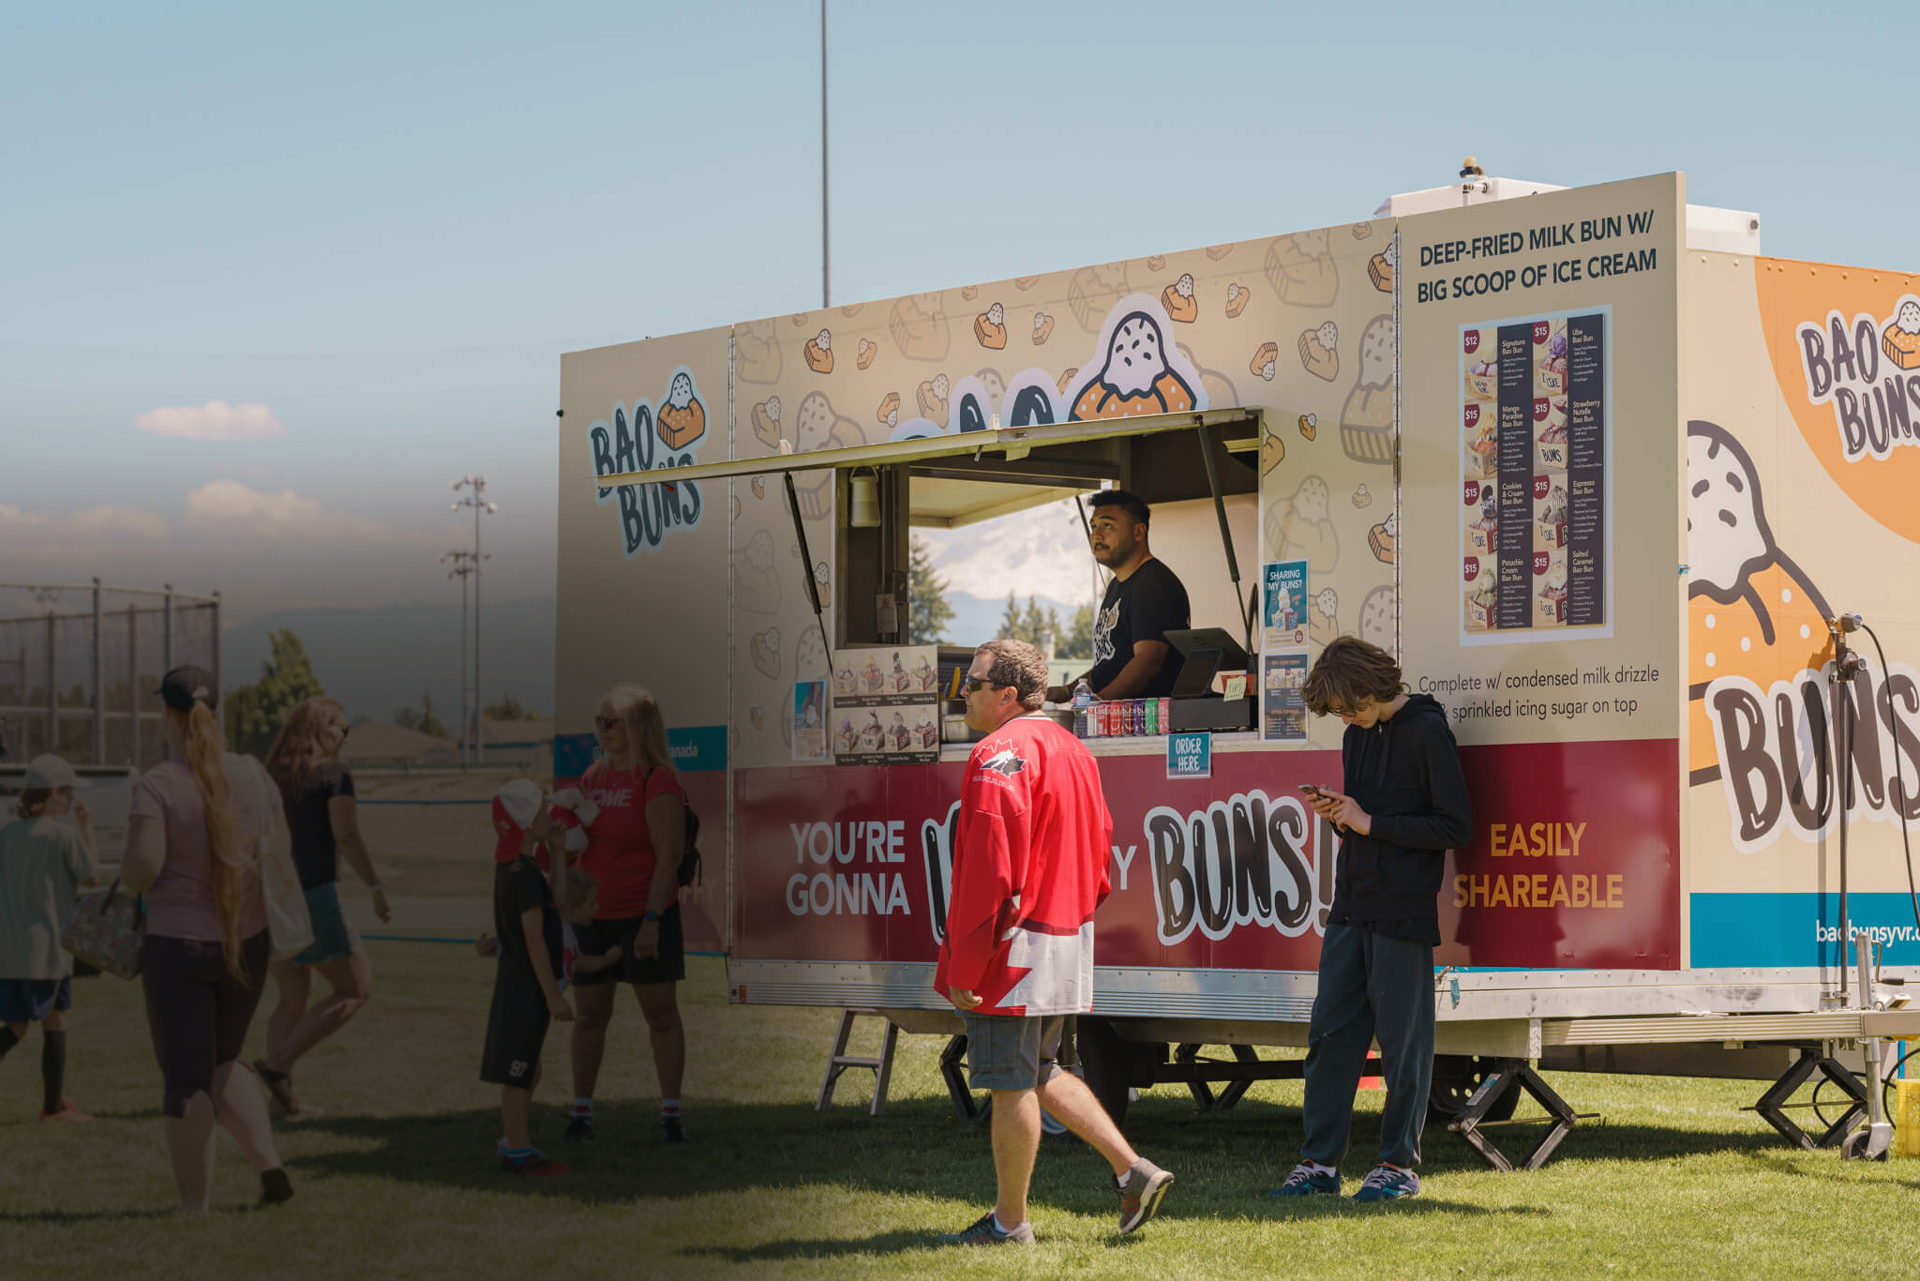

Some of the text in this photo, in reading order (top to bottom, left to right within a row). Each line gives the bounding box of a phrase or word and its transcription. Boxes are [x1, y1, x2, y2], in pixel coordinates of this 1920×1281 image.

[1420, 209, 1655, 267] DEEP-FRIED MILK BUN W/
[1418, 248, 1657, 303] BIG SCOOP OF ICE CREAM
[1534, 326, 1547, 337] $15
[1465, 336, 1478, 346] $12
[1801, 317, 1878, 397] BAO
[1465, 410, 1478, 420] $15
[1535, 403, 1548, 414] $15
[591, 404, 654, 499] BAO
[1465, 488, 1478, 498] $15
[1535, 481, 1548, 491] $15
[1464, 563, 1477, 574] $15
[1534, 557, 1547, 567] $15
[1269, 569, 1301, 581] SHARING
[1267, 581, 1280, 591] MY
[1418, 662, 1660, 696] Complete w/ condensed milk drizzle
[1452, 698, 1512, 724] sprinkled
[1516, 698, 1547, 720] icing
[1551, 700, 1589, 720] sugar
[1592, 700, 1610, 714] on
[1614, 697, 1639, 717] top
[1175, 738, 1202, 755] ORDER
[1177, 756, 1200, 772] HERE
[789, 820, 906, 864] YOU'RE
[1490, 822, 1587, 857] EASILY
[1111, 798, 1336, 938] Y BUNS!
[786, 872, 911, 916] GONNA
[1453, 874, 1624, 908] SHAREABLE
[509, 1059, 528, 1078] 97
